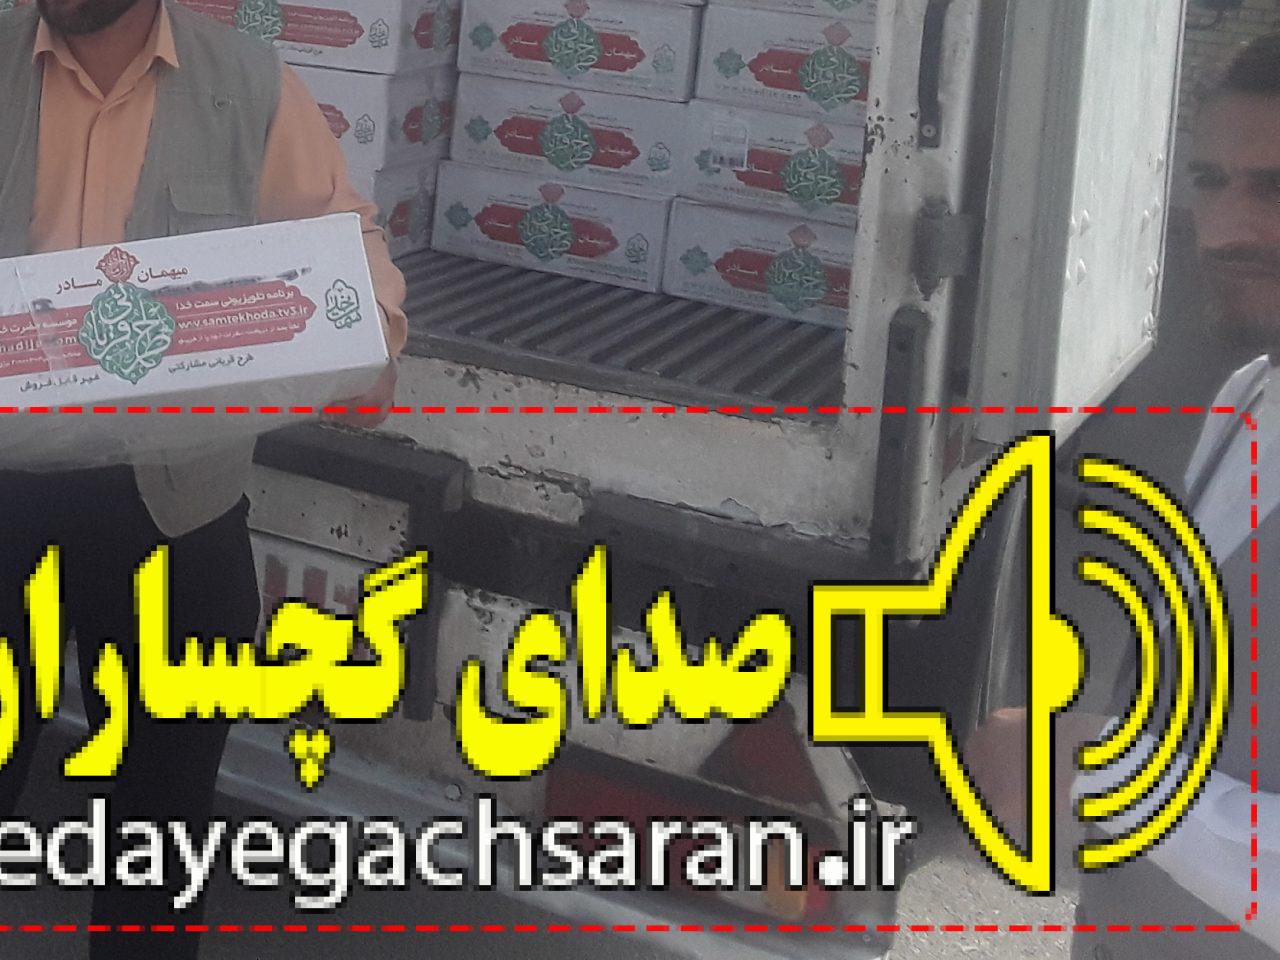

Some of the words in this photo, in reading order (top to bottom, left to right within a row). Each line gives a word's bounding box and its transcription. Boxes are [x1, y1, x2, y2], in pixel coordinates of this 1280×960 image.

[136, 266, 189, 283] میهمان
[56, 277, 103, 294] مادر
[266, 289, 294, 300] برنامه
[175, 301, 193, 310] خدا
[194, 300, 219, 309] سمت
[237, 352, 255, 367] طرح
